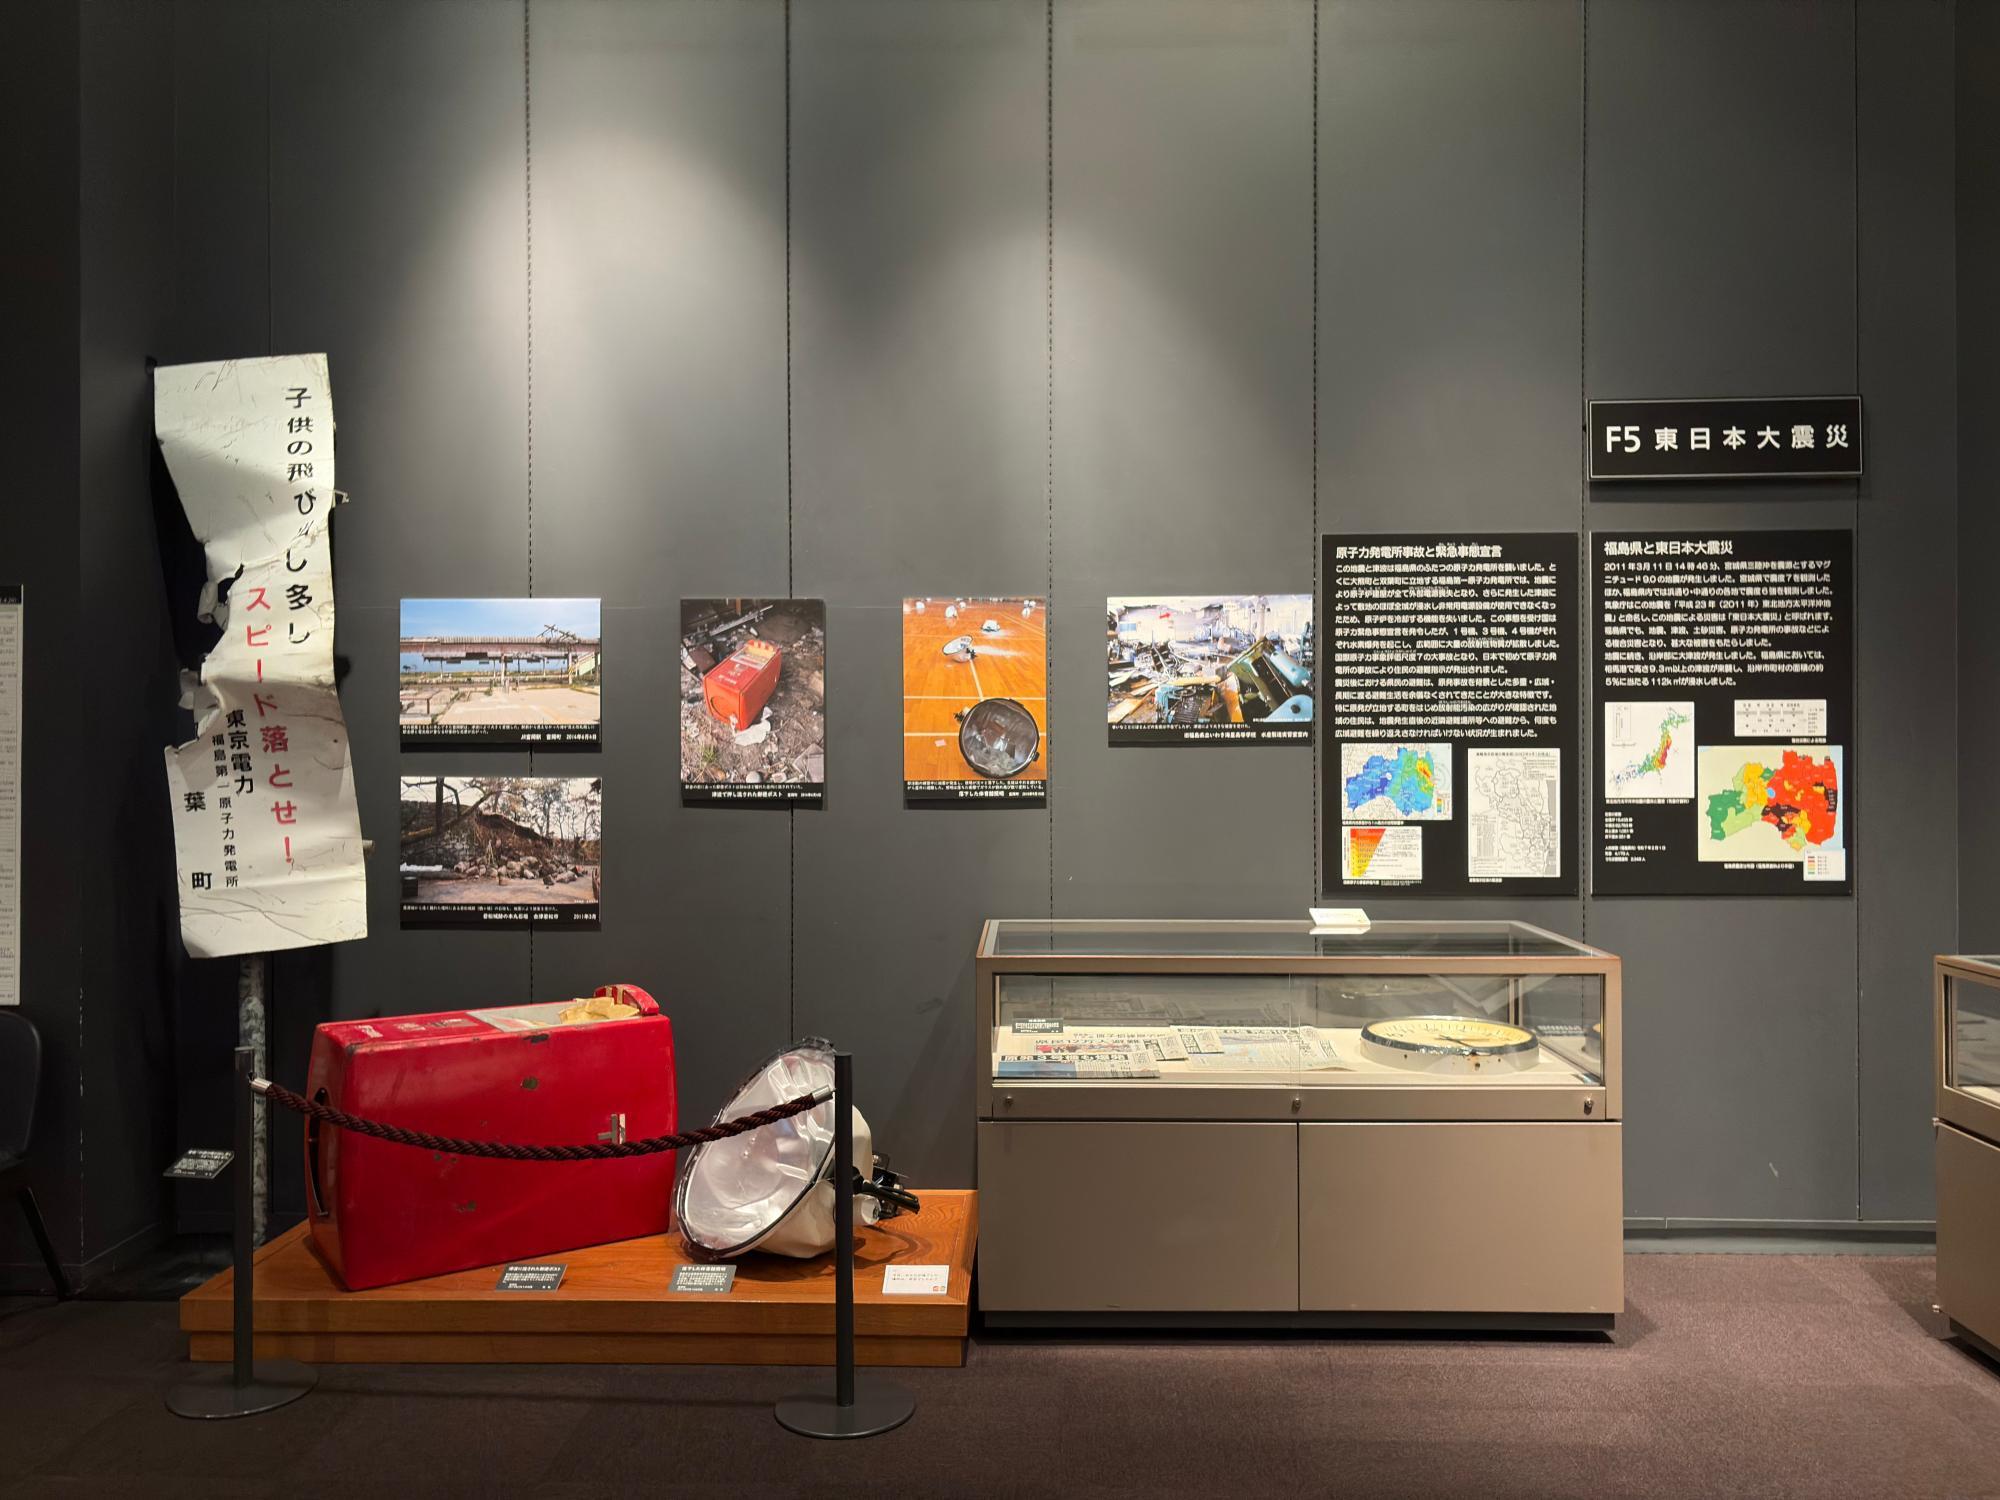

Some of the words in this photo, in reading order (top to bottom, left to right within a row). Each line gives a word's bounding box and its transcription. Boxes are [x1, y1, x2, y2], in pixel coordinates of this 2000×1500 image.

[1607, 426, 1640, 452] F5
[1655, 425, 1848, 451] 東日本大震災
[1604, 540, 1733, 556] 福島県と東日本大震災
[226, 710, 254, 795] 東京電力
[212, 734, 238, 888] 福島第一原子力発電所
